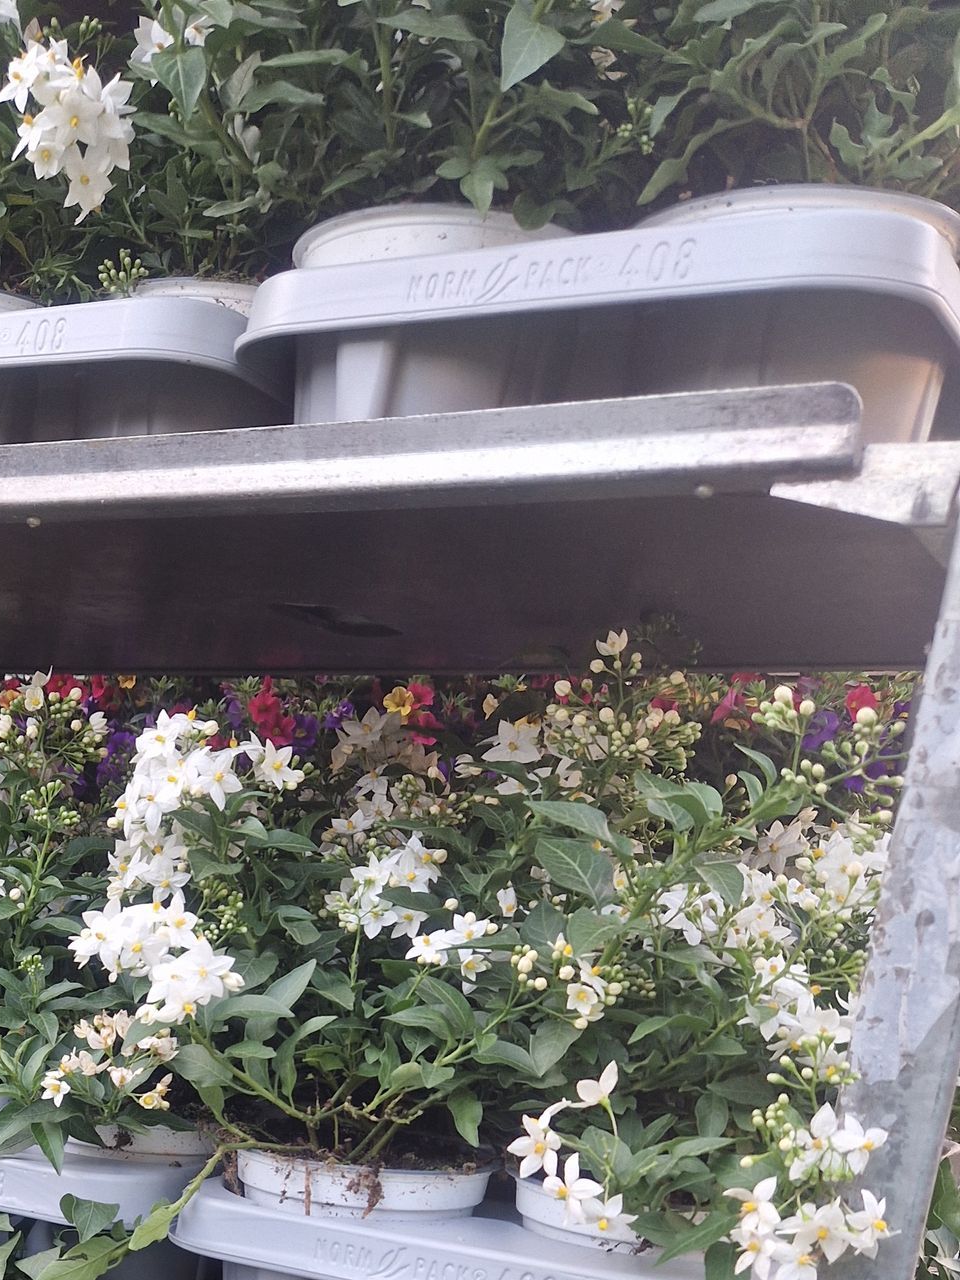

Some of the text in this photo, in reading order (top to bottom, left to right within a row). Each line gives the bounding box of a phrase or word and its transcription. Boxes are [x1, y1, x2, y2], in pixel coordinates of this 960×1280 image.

[406, 268, 476, 303] NORM
[618, 237, 698, 286] 408
[15, 316, 67, 354] 408
[312, 1237, 373, 1272] NORM
